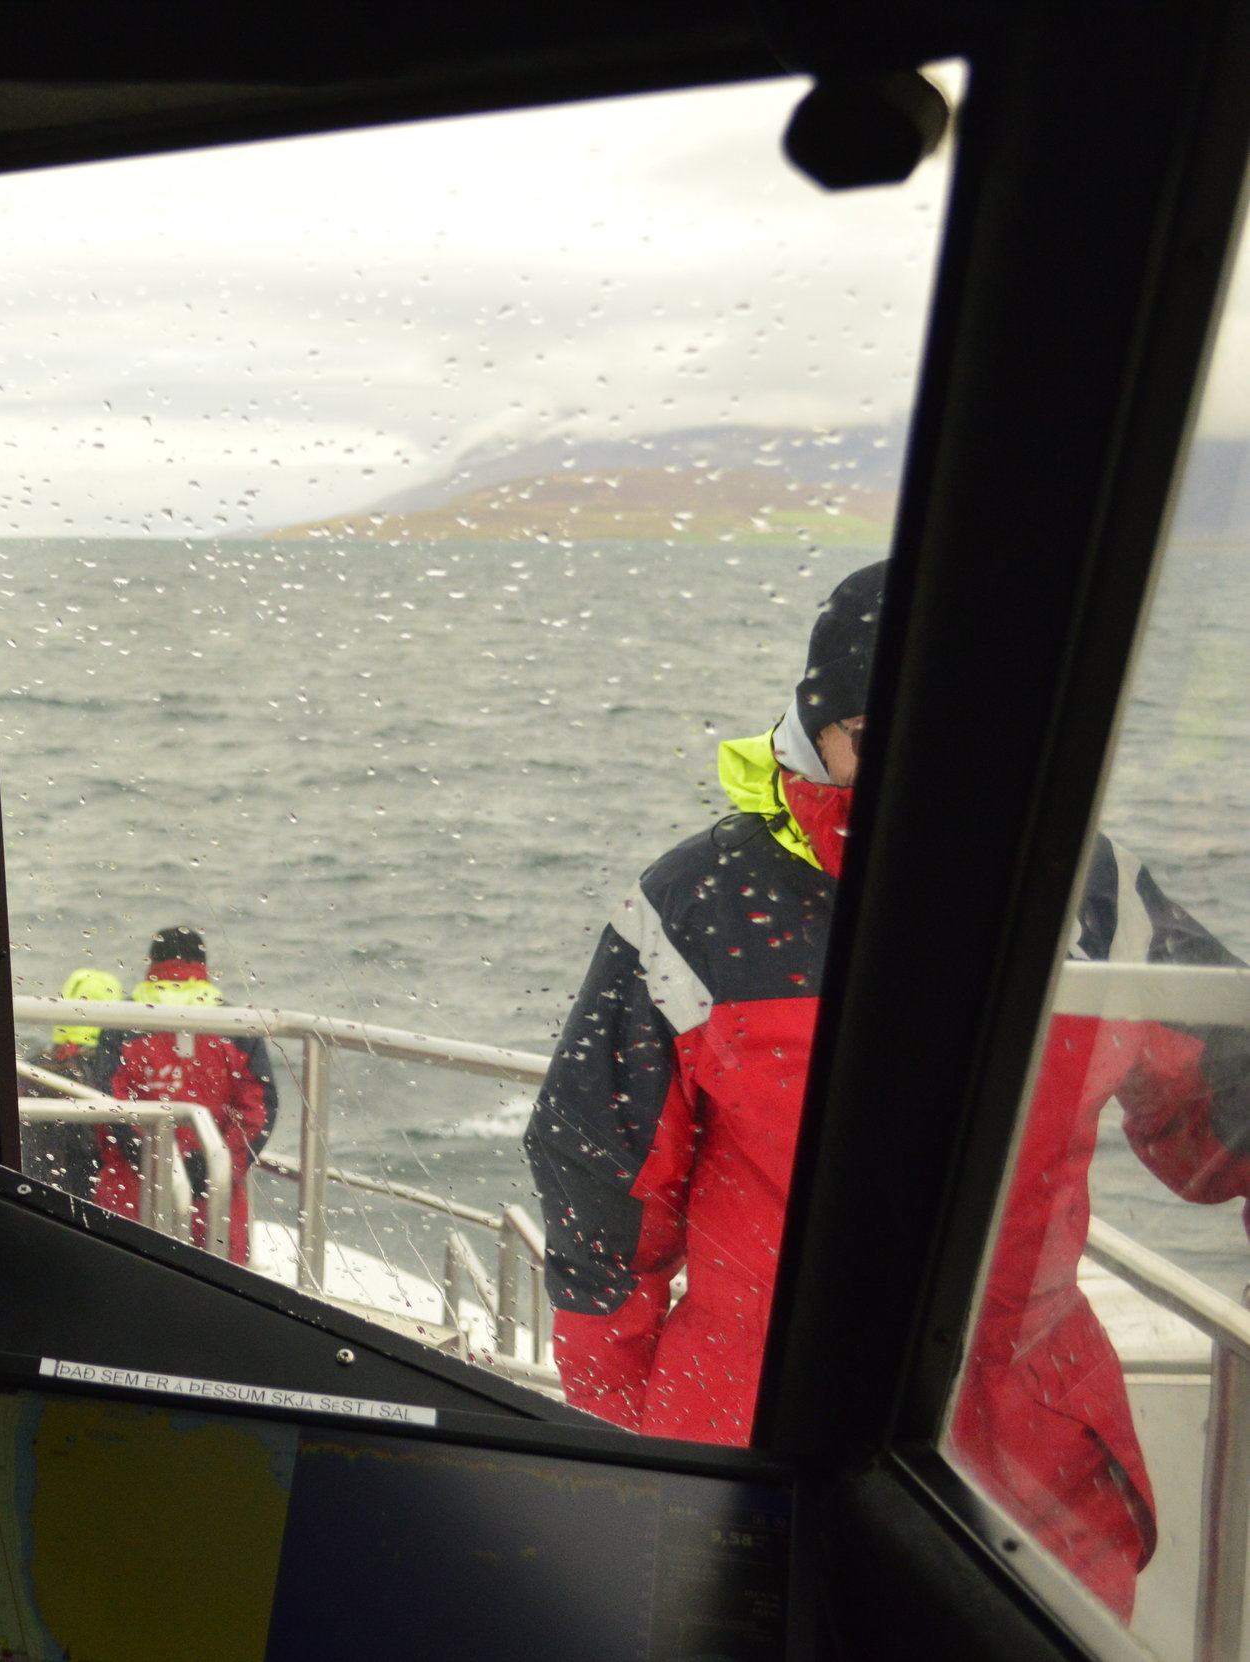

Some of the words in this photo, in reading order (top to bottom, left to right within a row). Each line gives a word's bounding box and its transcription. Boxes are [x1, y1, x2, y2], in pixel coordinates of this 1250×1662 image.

[59, 1363, 96, 1380] ÞAÐ
[100, 1369, 139, 1387] SEM
[144, 1375, 169, 1390] ER
[189, 1381, 266, 1403] ÞESSUM
[379, 1404, 413, 1422] SAL
[711, 1530, 753, 1547] 9,58
